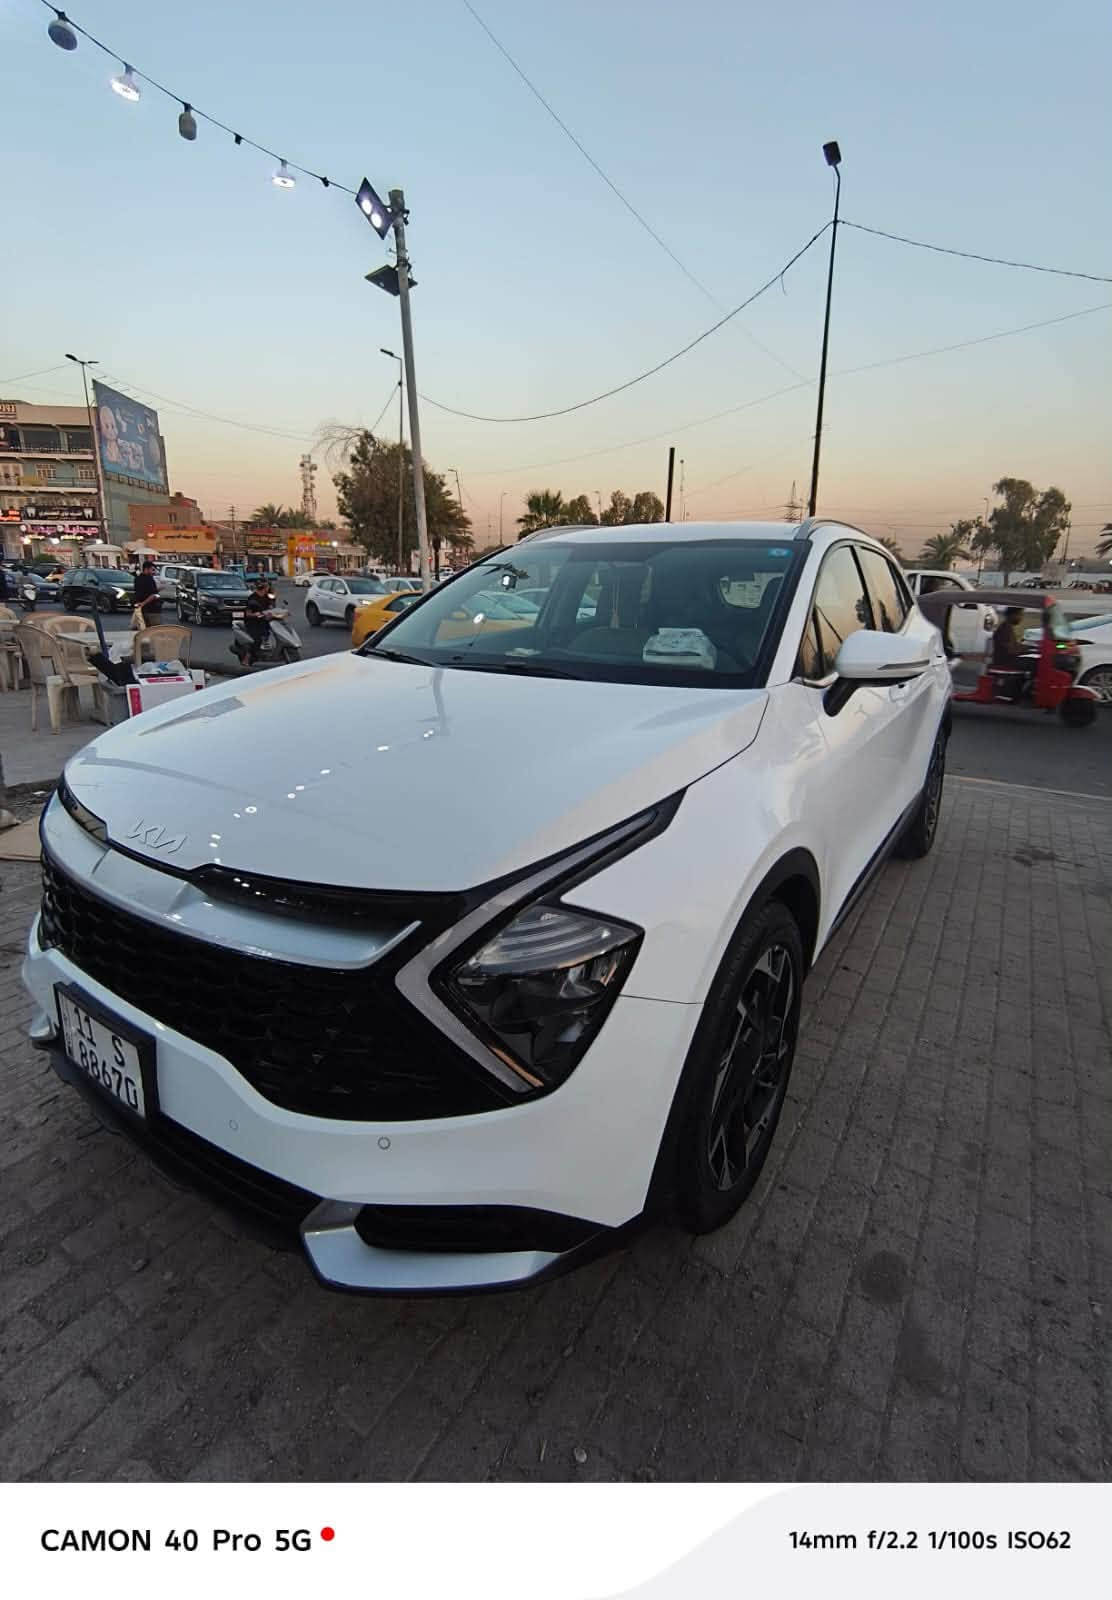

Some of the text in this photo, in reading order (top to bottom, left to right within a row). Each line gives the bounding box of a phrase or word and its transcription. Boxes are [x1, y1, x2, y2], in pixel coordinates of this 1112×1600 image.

[127, 817, 188, 854] KIA
[74, 1007, 97, 1047] 11
[112, 1034, 125, 1067] S
[79, 1041, 139, 1109] 88670
